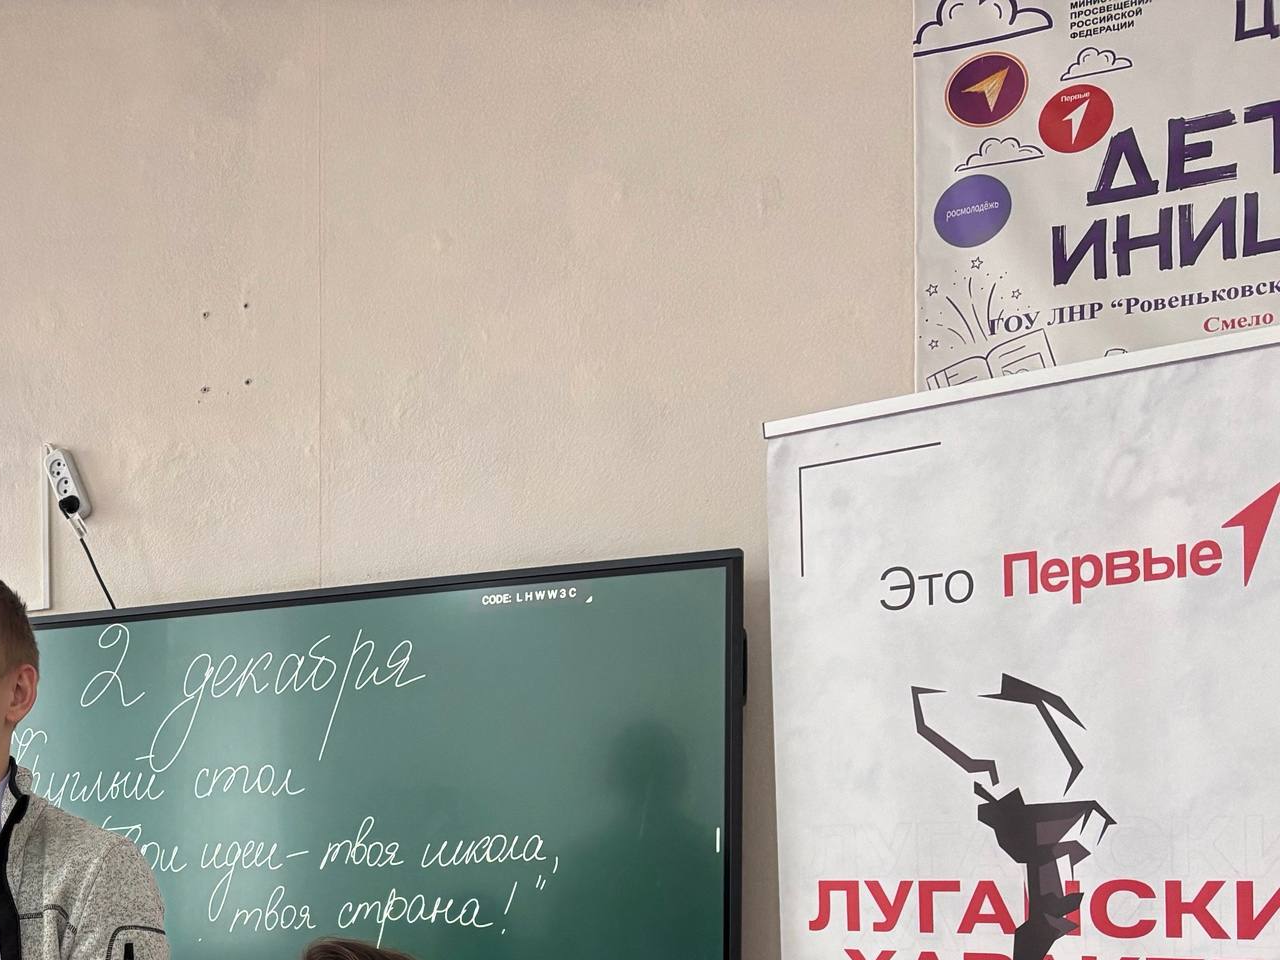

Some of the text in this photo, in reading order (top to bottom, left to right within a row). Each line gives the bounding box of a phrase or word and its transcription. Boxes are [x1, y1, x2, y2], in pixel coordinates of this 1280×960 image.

[1070, 7, 1143, 30] РОССИЙСКОЙ
[1070, 20, 1135, 39] ФЕДЕРАЦИИ
[988, 311, 1040, 336] ГОУ
[1047, 302, 1104, 326] ЛНР
[1203, 312, 1274, 333] Смело
[879, 537, 1223, 611] Это Первые
[481, 593, 512, 605] CODE:
[80, 623, 426, 772] 2 декабря
[193, 763, 306, 797] стол
[320, 816, 404, 870] твоя
[229, 886, 317, 933] твоя
[809, 879, 1280, 941] ЛУГАСКИ
